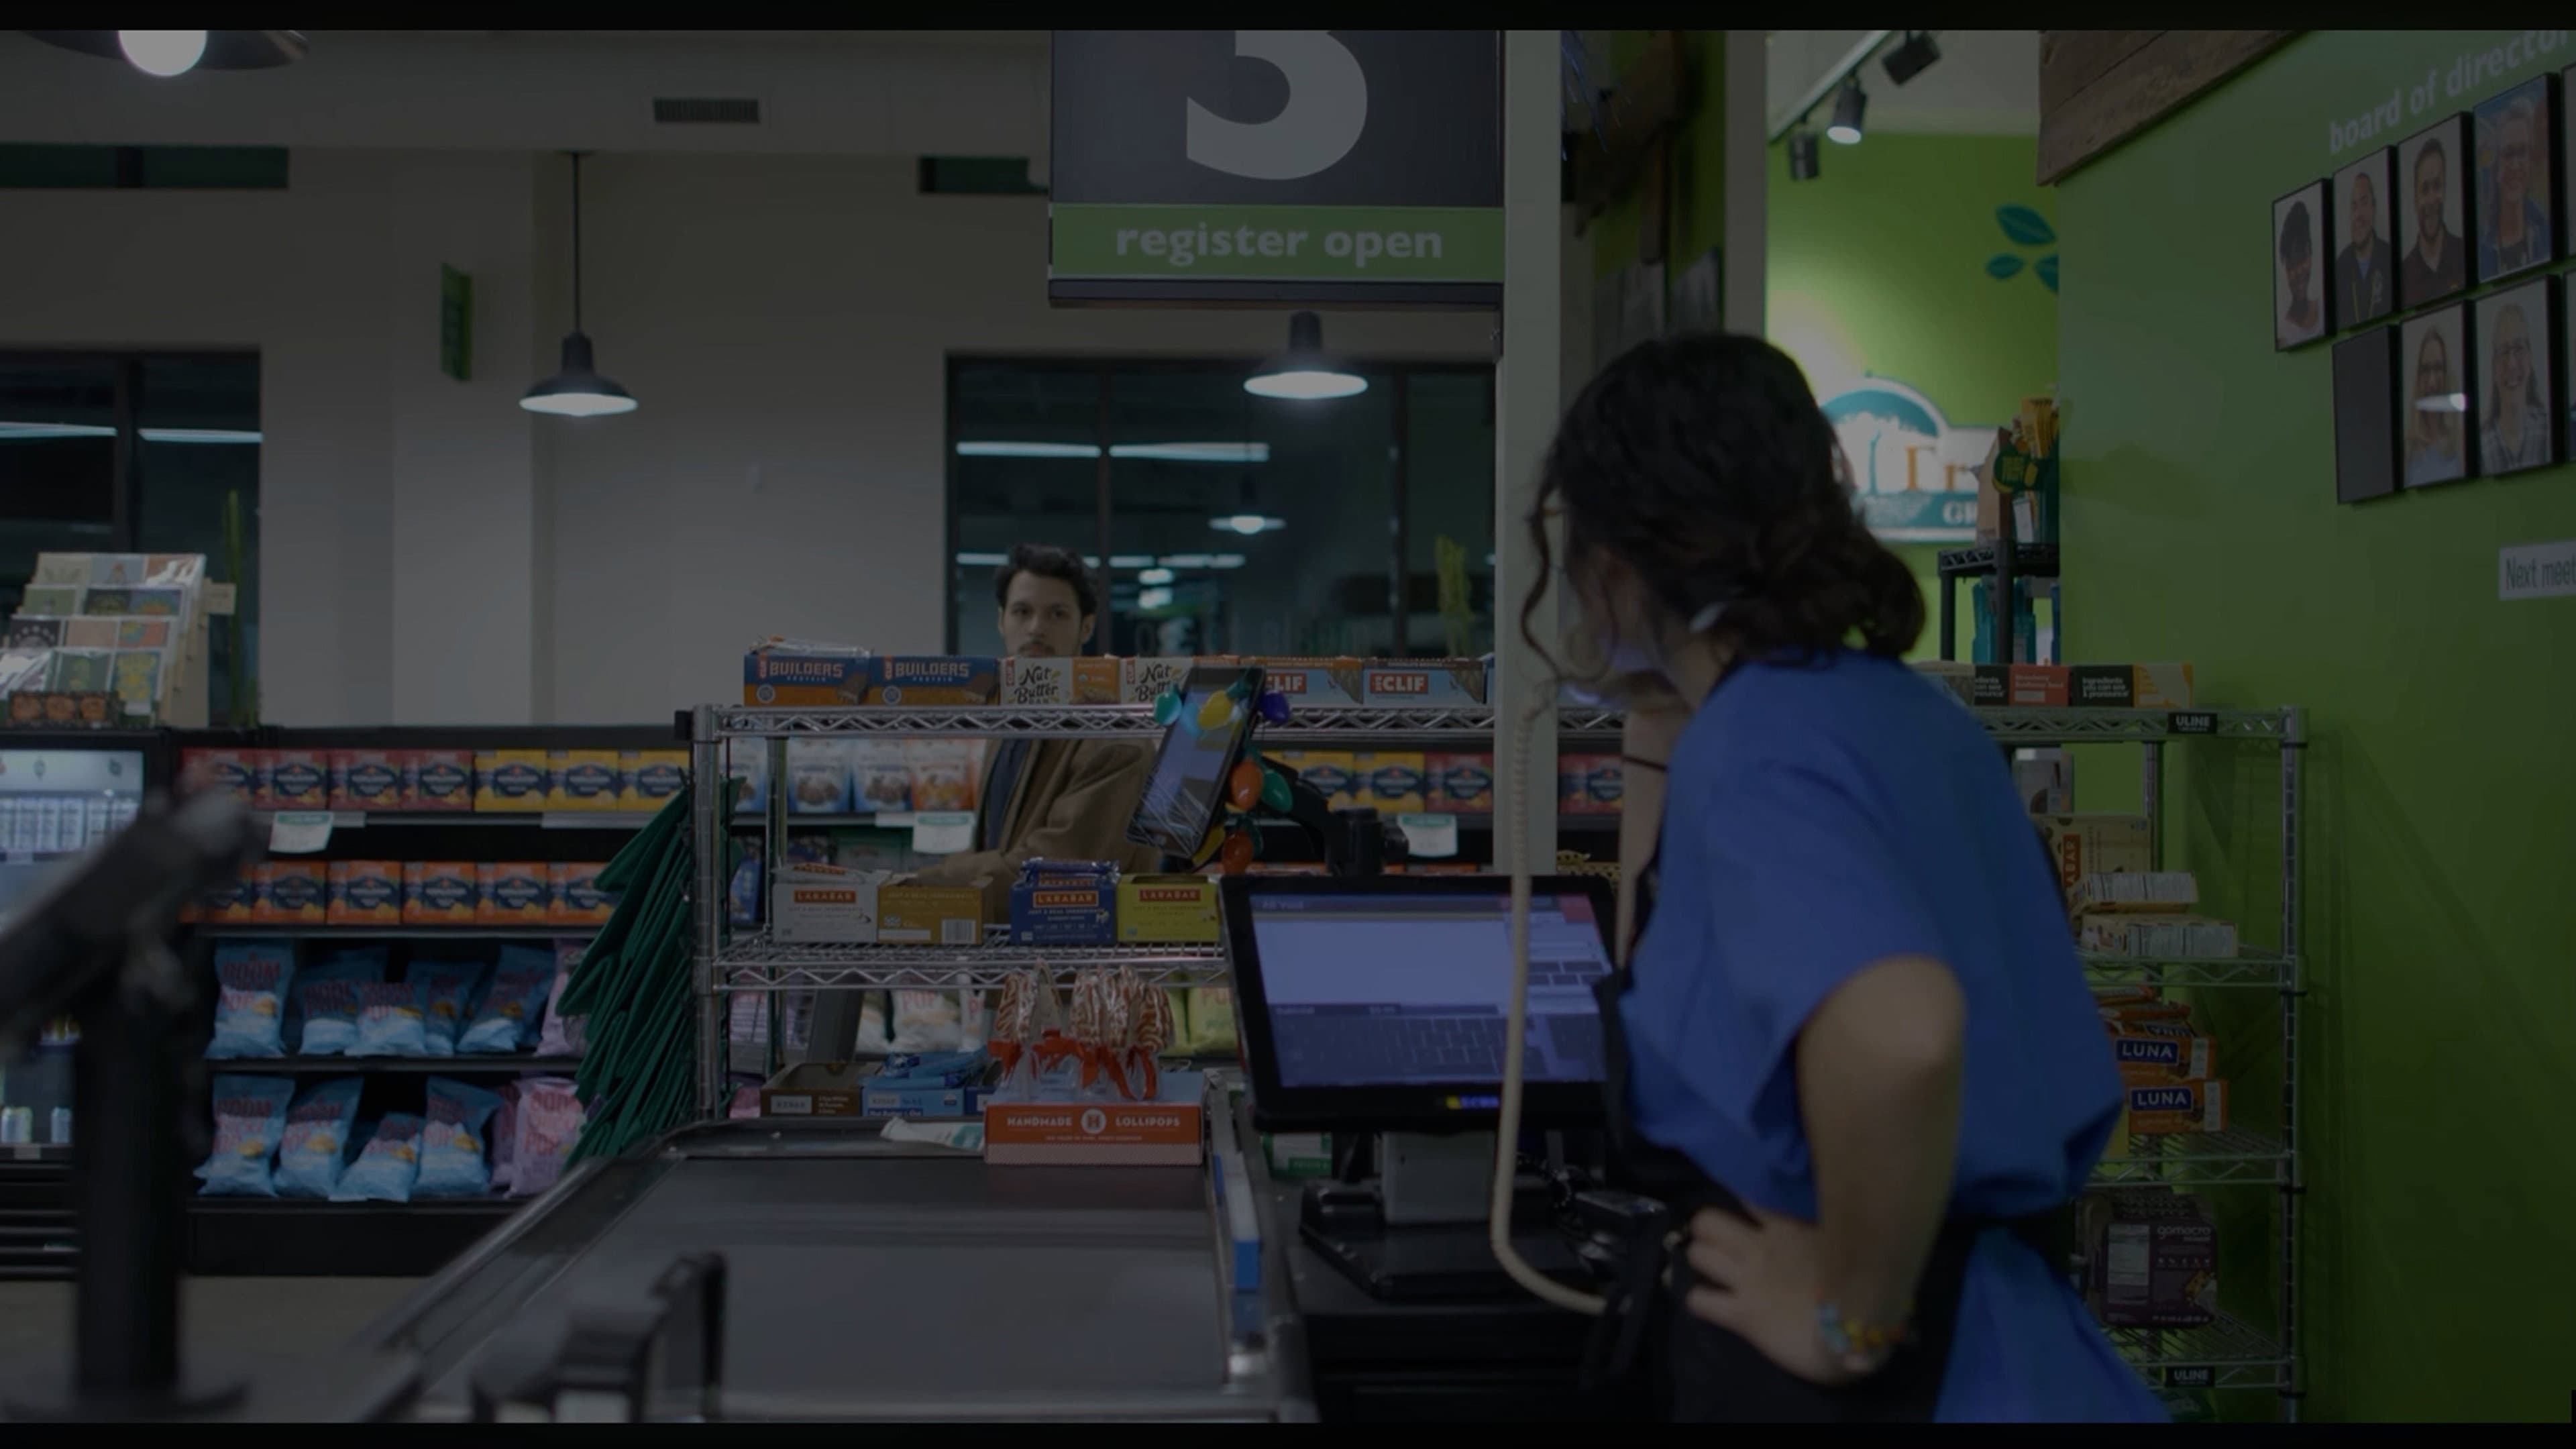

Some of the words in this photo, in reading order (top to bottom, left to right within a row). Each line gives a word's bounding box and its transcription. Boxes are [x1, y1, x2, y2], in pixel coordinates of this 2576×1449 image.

[2330, 88, 2400, 154] board
[2410, 69, 2436, 115] of
[1116, 221, 1308, 267] register
[1324, 230, 1442, 268] open
[2506, 556, 2537, 590] Next
[769, 661, 843, 678] BUILDERS
[895, 661, 970, 678] BUILDERS
[1020, 665, 1049, 686] Nut
[1141, 664, 1171, 684] Nut
[1382, 676, 1425, 692] CLIF
[1014, 683, 1058, 704] Butter
[2176, 715, 2210, 727] ULINE
[1037, 894, 1093, 904] LARABAR
[1142, 890, 1198, 900] LARABAR
[2121, 1042, 2174, 1058] LUNA
[2137, 1091, 2188, 1106] LUNA
[1007, 1116, 1072, 1127] HANDMADE
[1116, 1116, 1181, 1128] LOLLIPOPS
[2157, 1225, 2212, 1240] gomacro
[2174, 1369, 2209, 1381] ULINE
